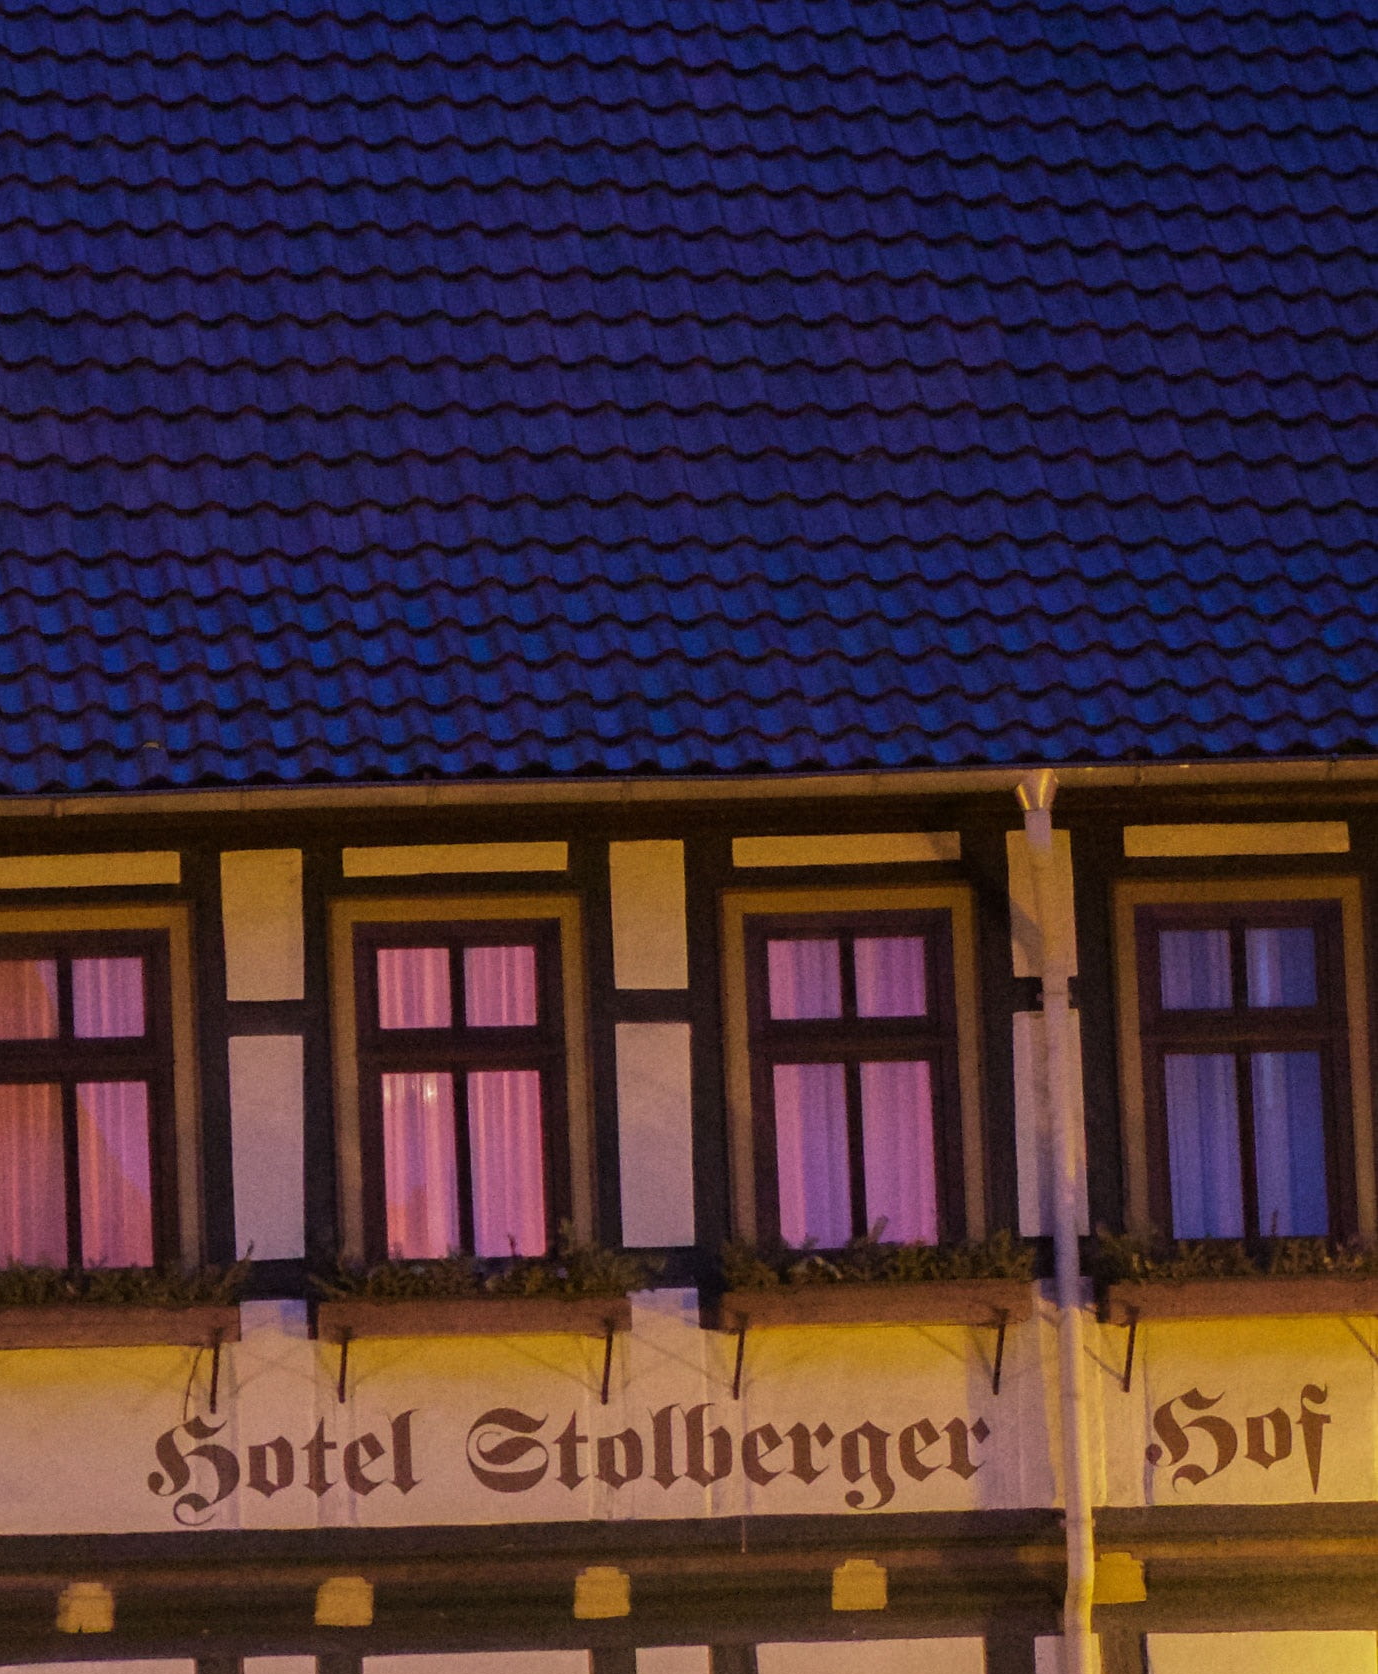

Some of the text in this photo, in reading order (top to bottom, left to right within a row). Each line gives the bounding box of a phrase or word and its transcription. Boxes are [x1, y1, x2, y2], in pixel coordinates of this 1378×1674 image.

[147, 1383, 1332, 1527] Hotel Stolberger Hof
